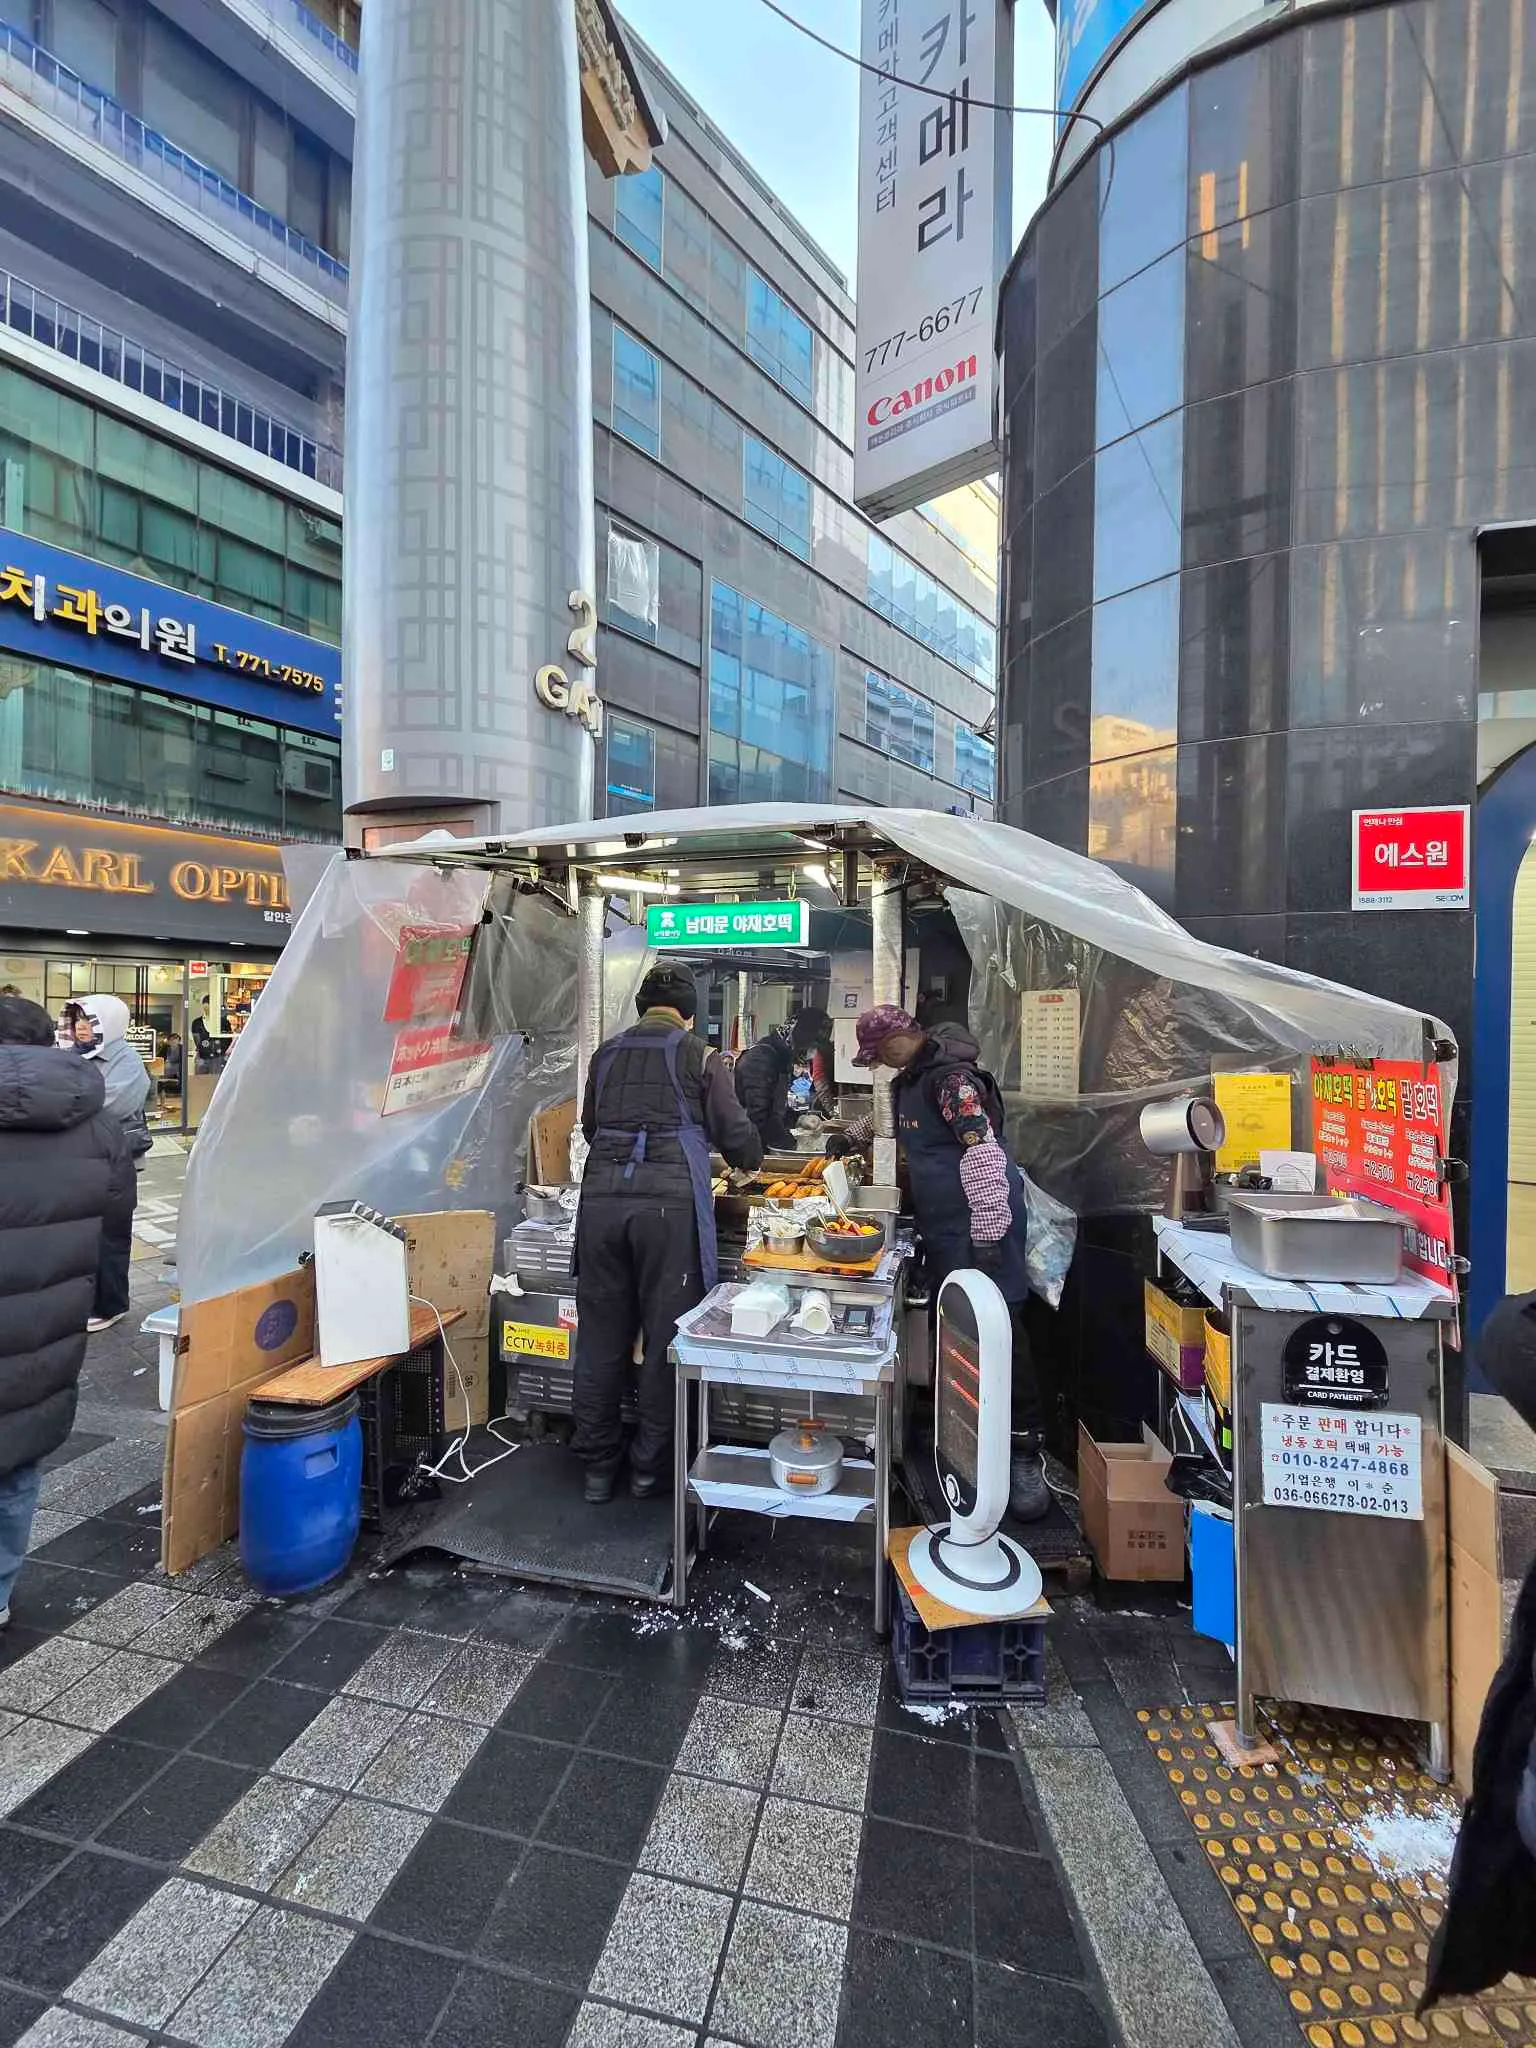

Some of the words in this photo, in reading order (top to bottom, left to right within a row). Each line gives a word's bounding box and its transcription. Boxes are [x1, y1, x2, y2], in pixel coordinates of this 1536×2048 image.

[864, 285, 983, 374] 777-6677
[867, 353, 976, 427] Canon
[0, 565, 196, 665] 치과의원
[213, 643, 232, 665] T.
[236, 650, 324, 693] 771-7575
[0, 836, 156, 895] KARL
[1374, 840, 1449, 868] 에스원
[685, 915, 729, 934] 남대문
[732, 913, 793, 934] 야채호떡
[1308, 1342, 1361, 1367] 카드
[1305, 1366, 1364, 1384] 결제환영
[1307, 1390, 1328, 1399] CARD
[1329, 1392, 1363, 1402] PAYMENT
[1281, 1413, 1312, 1431] 주문
[1318, 1417, 1347, 1434] 판매
[1353, 1419, 1402, 1439] 합니다
[1281, 1435, 1308, 1449] 냉동
[1312, 1438, 1338, 1451] 호떡
[1345, 1441, 1371, 1455] 택배
[1376, 1444, 1404, 1458] 가능
[1282, 1452, 1409, 1476] 010-8247-4868
[1284, 1473, 1336, 1488] 기업은행
